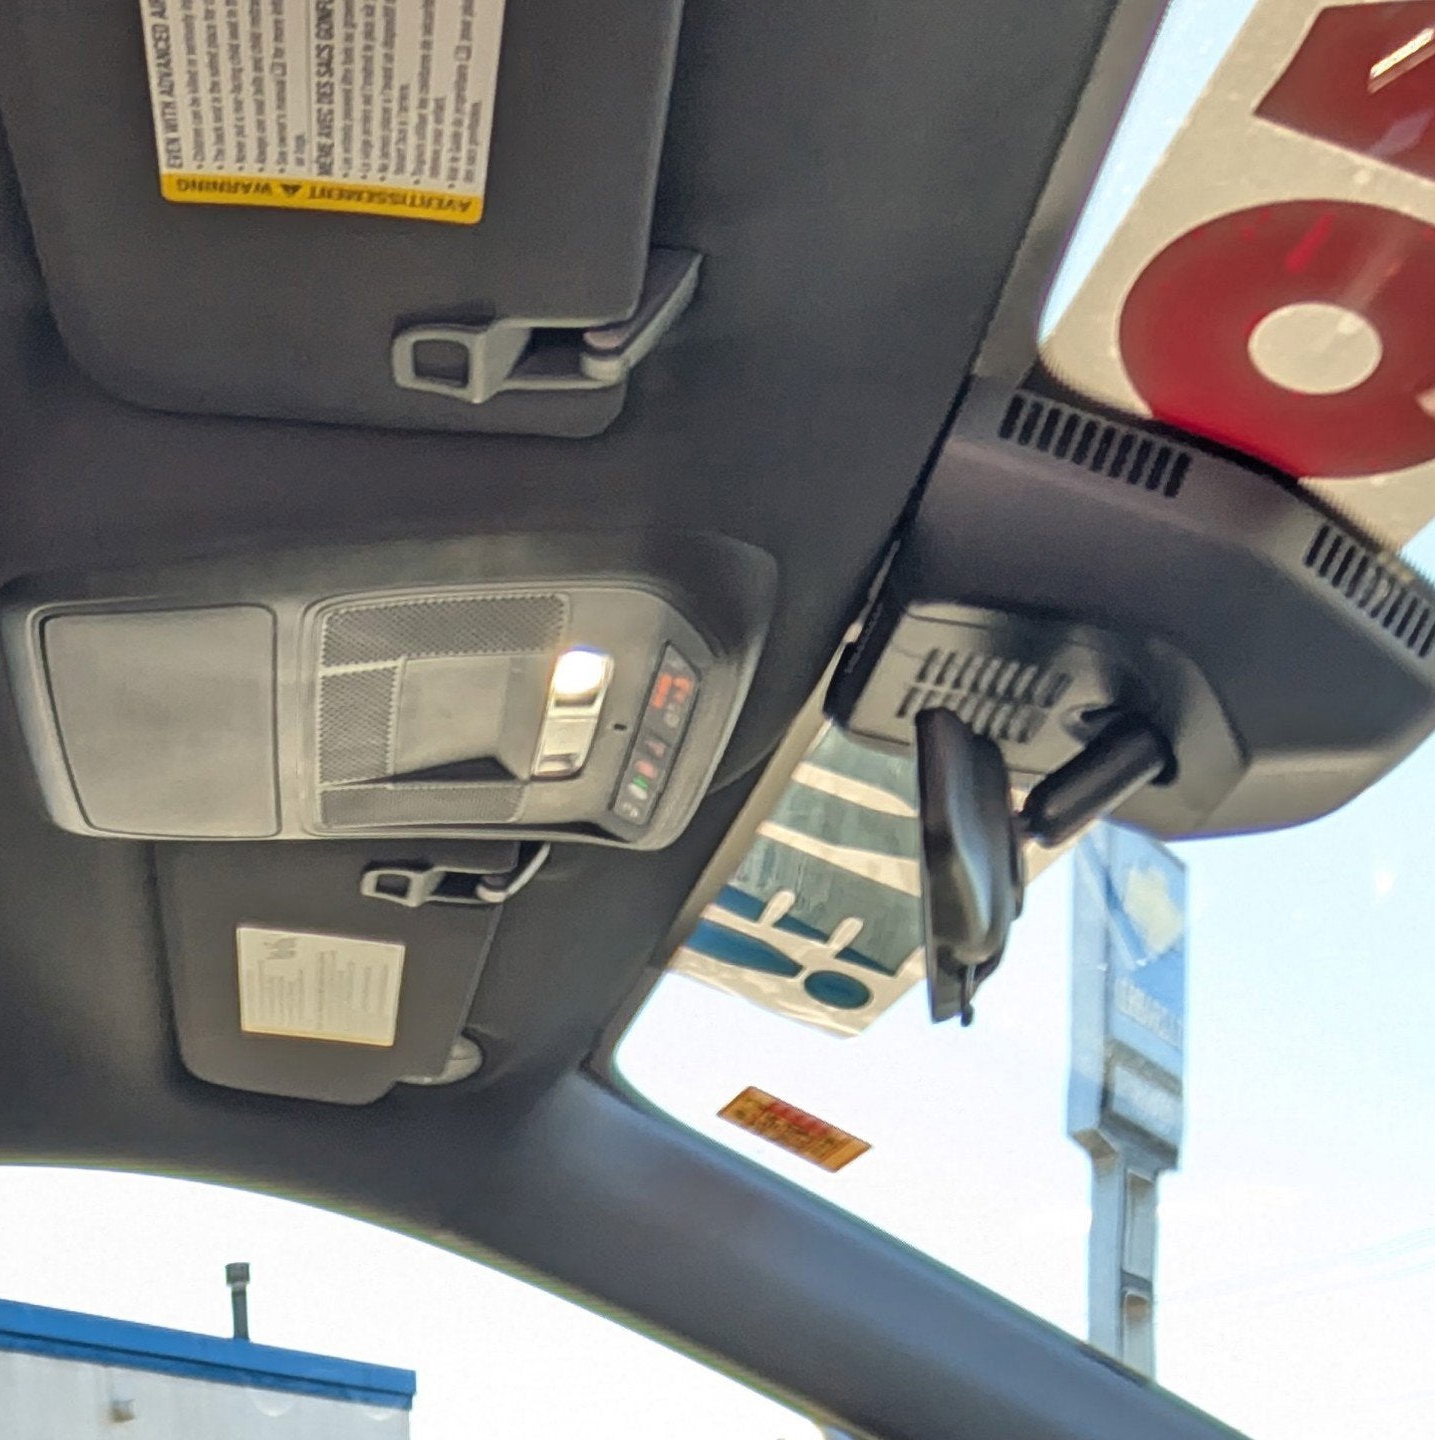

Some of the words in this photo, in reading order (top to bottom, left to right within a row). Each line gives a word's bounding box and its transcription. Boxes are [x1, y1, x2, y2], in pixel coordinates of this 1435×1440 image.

[151, 23, 175, 98] ADVANCED
[160, 100, 179, 134] WITH
[164, 136, 184, 170] EVEN
